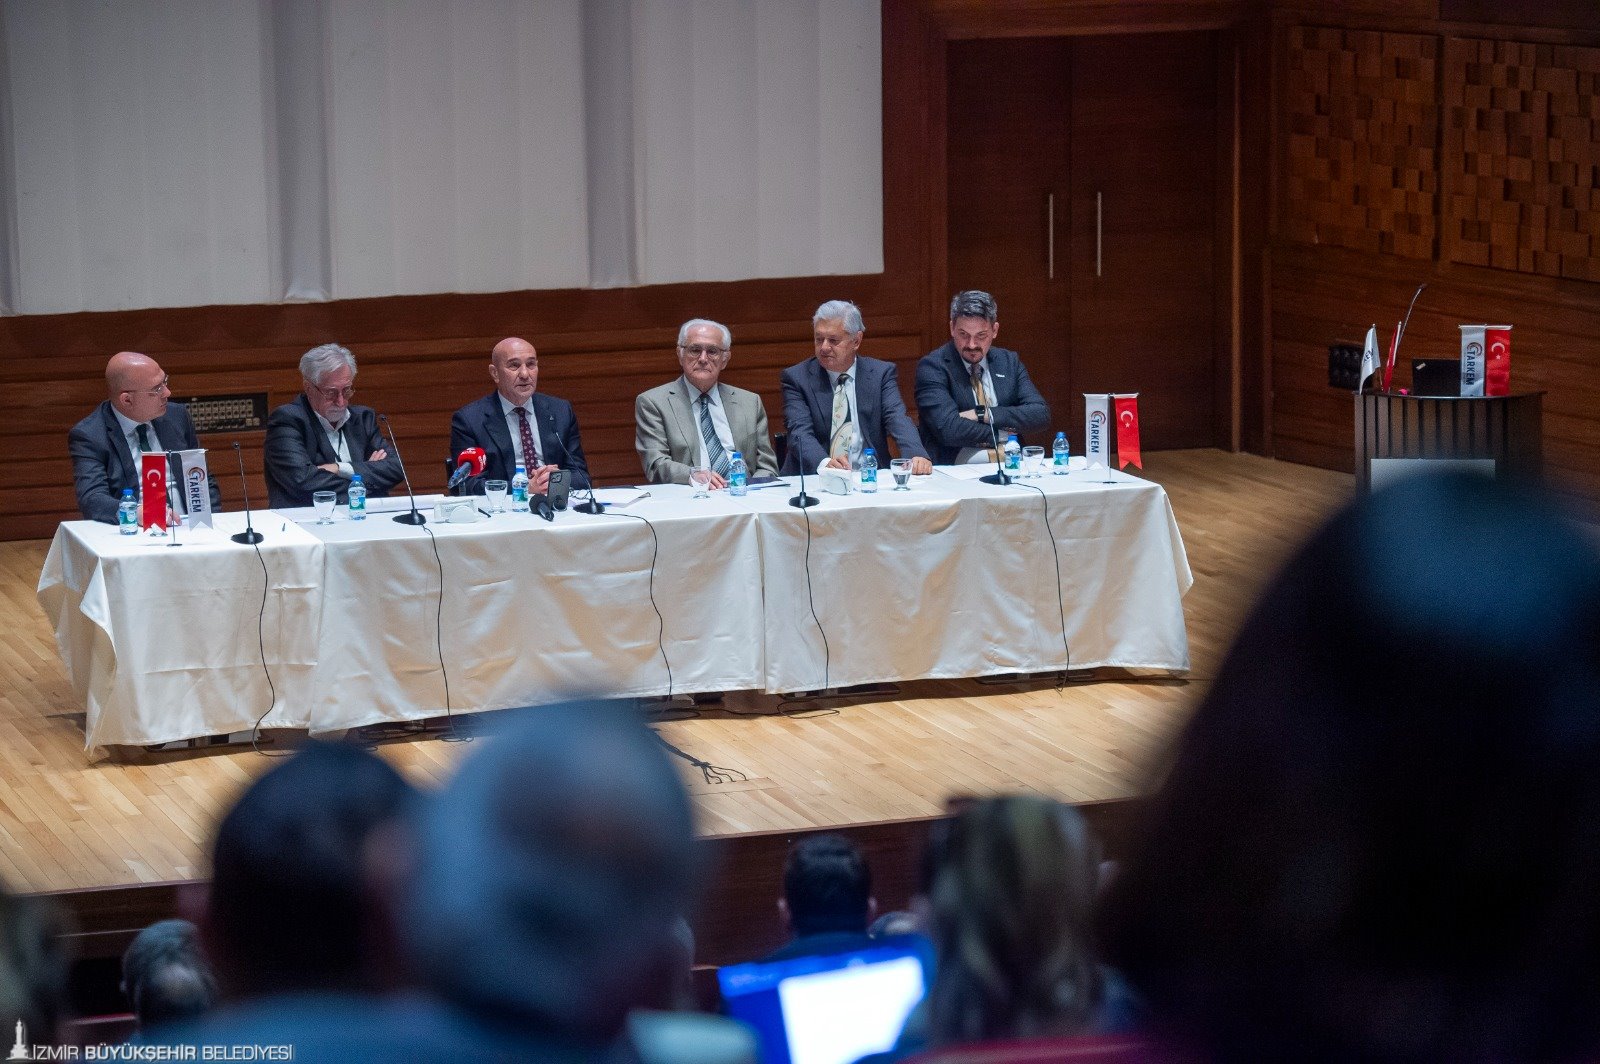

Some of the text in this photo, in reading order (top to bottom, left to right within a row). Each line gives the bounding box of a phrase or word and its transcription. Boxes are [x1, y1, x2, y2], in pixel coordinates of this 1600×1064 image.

[1466, 350, 1476, 386] TARKEM
[1090, 418, 1100, 454] TARKEM
[189, 475, 202, 513] TARKEM
